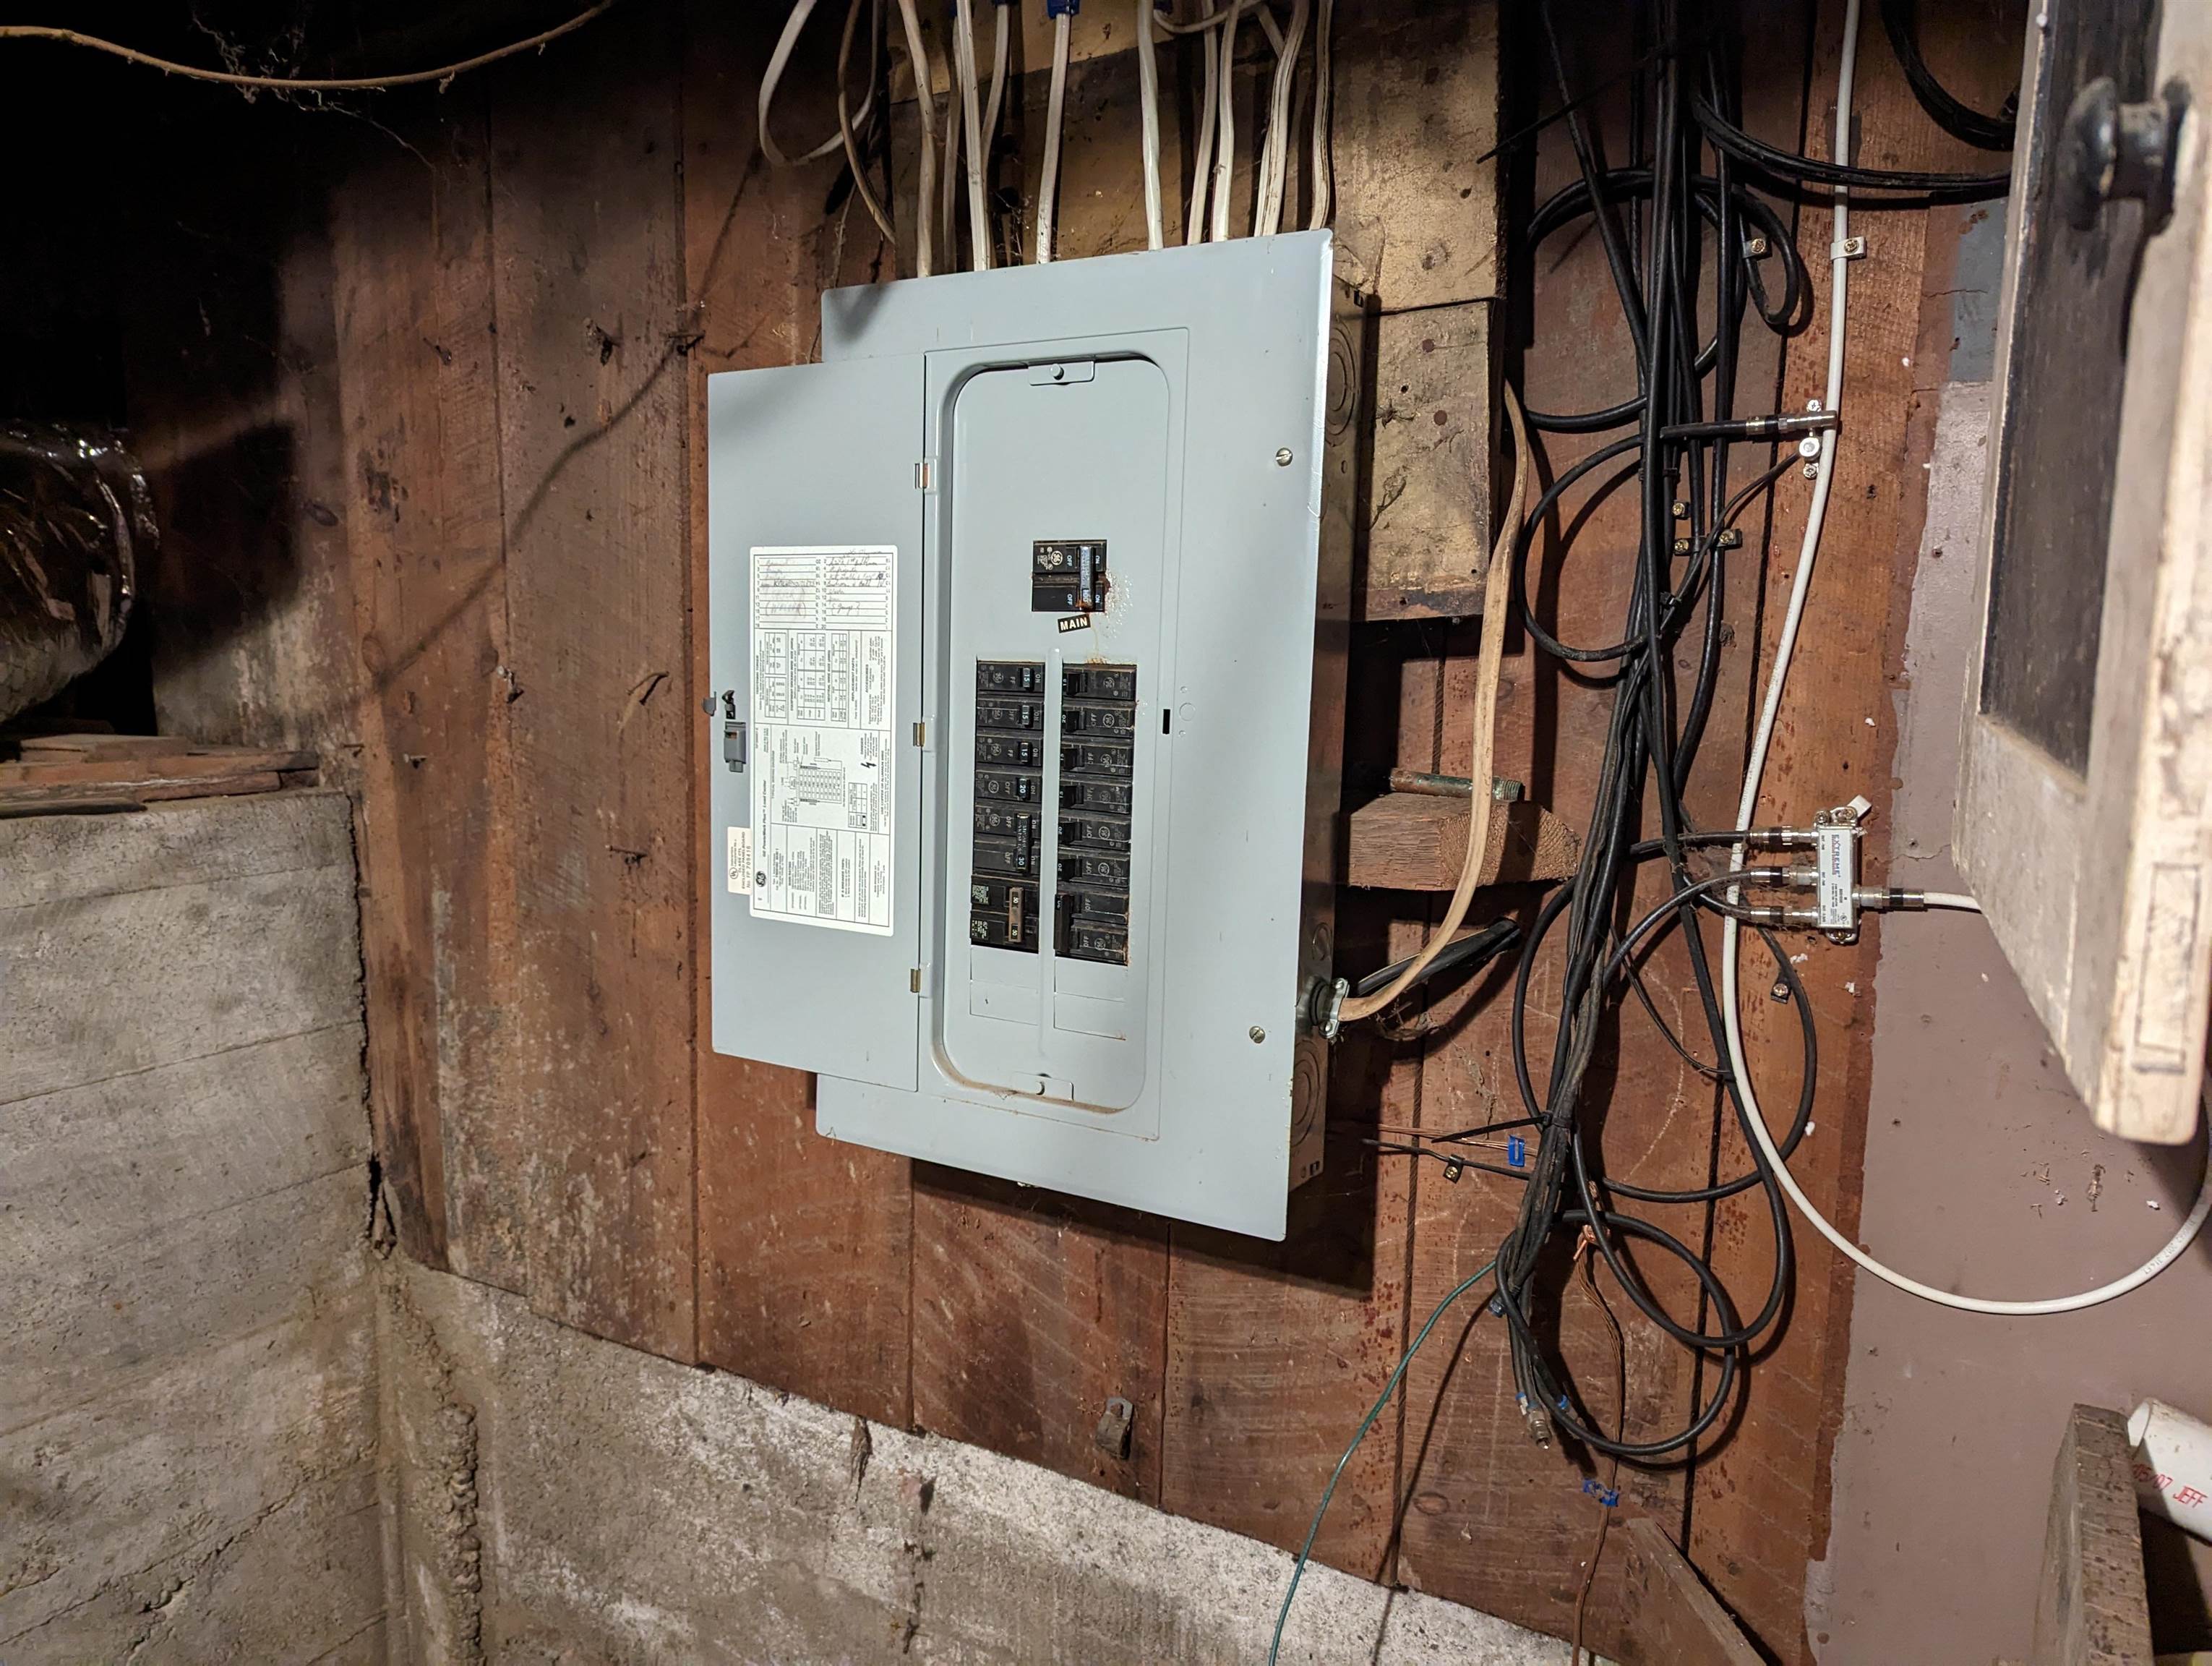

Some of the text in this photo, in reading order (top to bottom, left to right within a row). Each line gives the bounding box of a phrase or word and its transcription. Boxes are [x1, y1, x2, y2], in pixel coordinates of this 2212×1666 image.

[1095, 555, 1100, 564] ON
[1095, 594, 1100, 603] ON
[1060, 617, 1088, 631] MAIN
[1024, 673, 1029, 683] 15
[1035, 674, 1041, 683] ON
[1023, 712, 1028, 720] 15
[1034, 712, 1039, 721] ON
[1062, 714, 1067, 723] 20
[1033, 748, 1038, 758] ON
[1020, 785, 1026, 794] 20
[1031, 785, 1036, 795] ON
[1019, 857, 1024, 866] 30
[2172, 1485, 2208, 1508] JEFF
